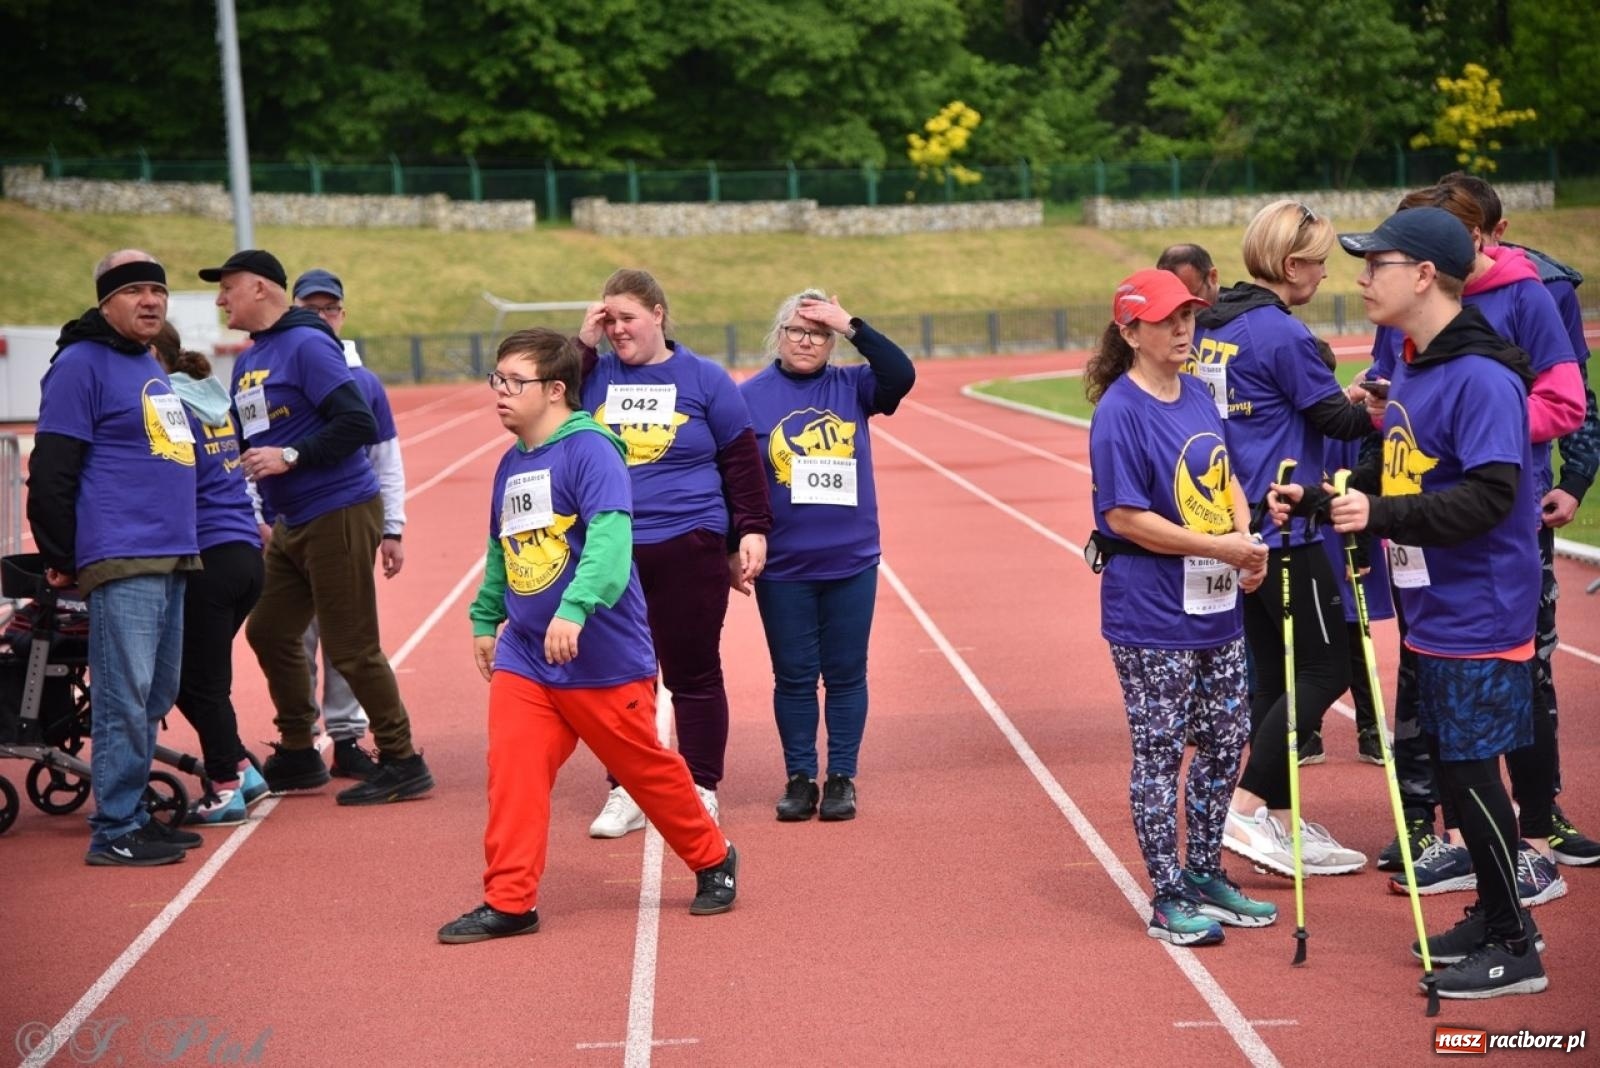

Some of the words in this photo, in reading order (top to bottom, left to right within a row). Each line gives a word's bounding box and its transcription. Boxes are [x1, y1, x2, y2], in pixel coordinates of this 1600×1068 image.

[621, 398, 659, 411] 042
[808, 473, 843, 489] 038
[511, 493, 532, 514] 118
[1206, 572, 1232, 595] 146
